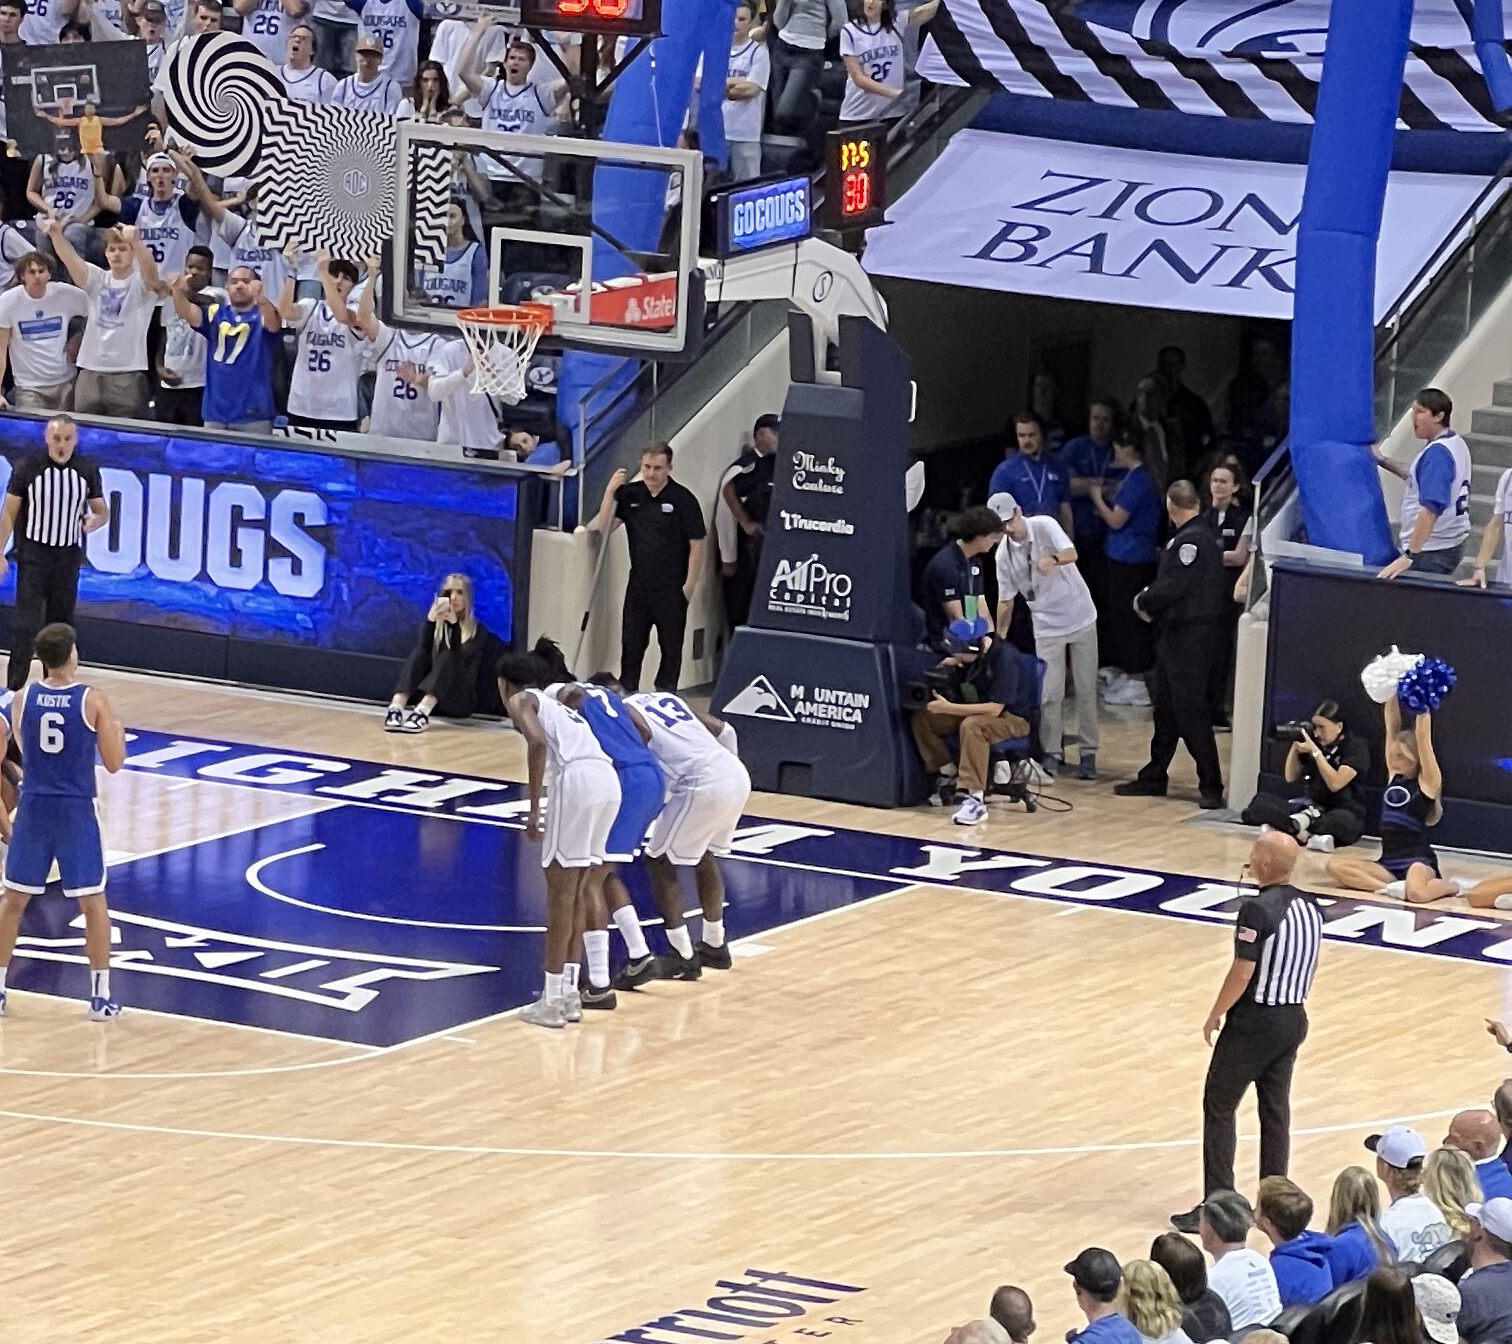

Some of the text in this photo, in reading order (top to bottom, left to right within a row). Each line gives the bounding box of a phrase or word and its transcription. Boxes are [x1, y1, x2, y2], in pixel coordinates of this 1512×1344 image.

[252, 14, 279, 36] 26
[54, 192, 76, 210] 26
[1013, 169, 1301, 234] ZION
[972, 219, 1297, 295] BANK
[213, 318, 251, 366] 17
[308, 349, 332, 372] 26
[392, 376, 418, 400] 26
[792, 450, 846, 484] Minky
[85, 465, 329, 598] OUGS
[770, 554, 852, 597] AllPro
[644, 697, 694, 729] 13
[790, 684, 870, 709] MUNTAIN
[793, 701, 863, 723] AMERICA
[39, 711, 66, 754] 6
[890, 844, 1512, 959] YOUN
